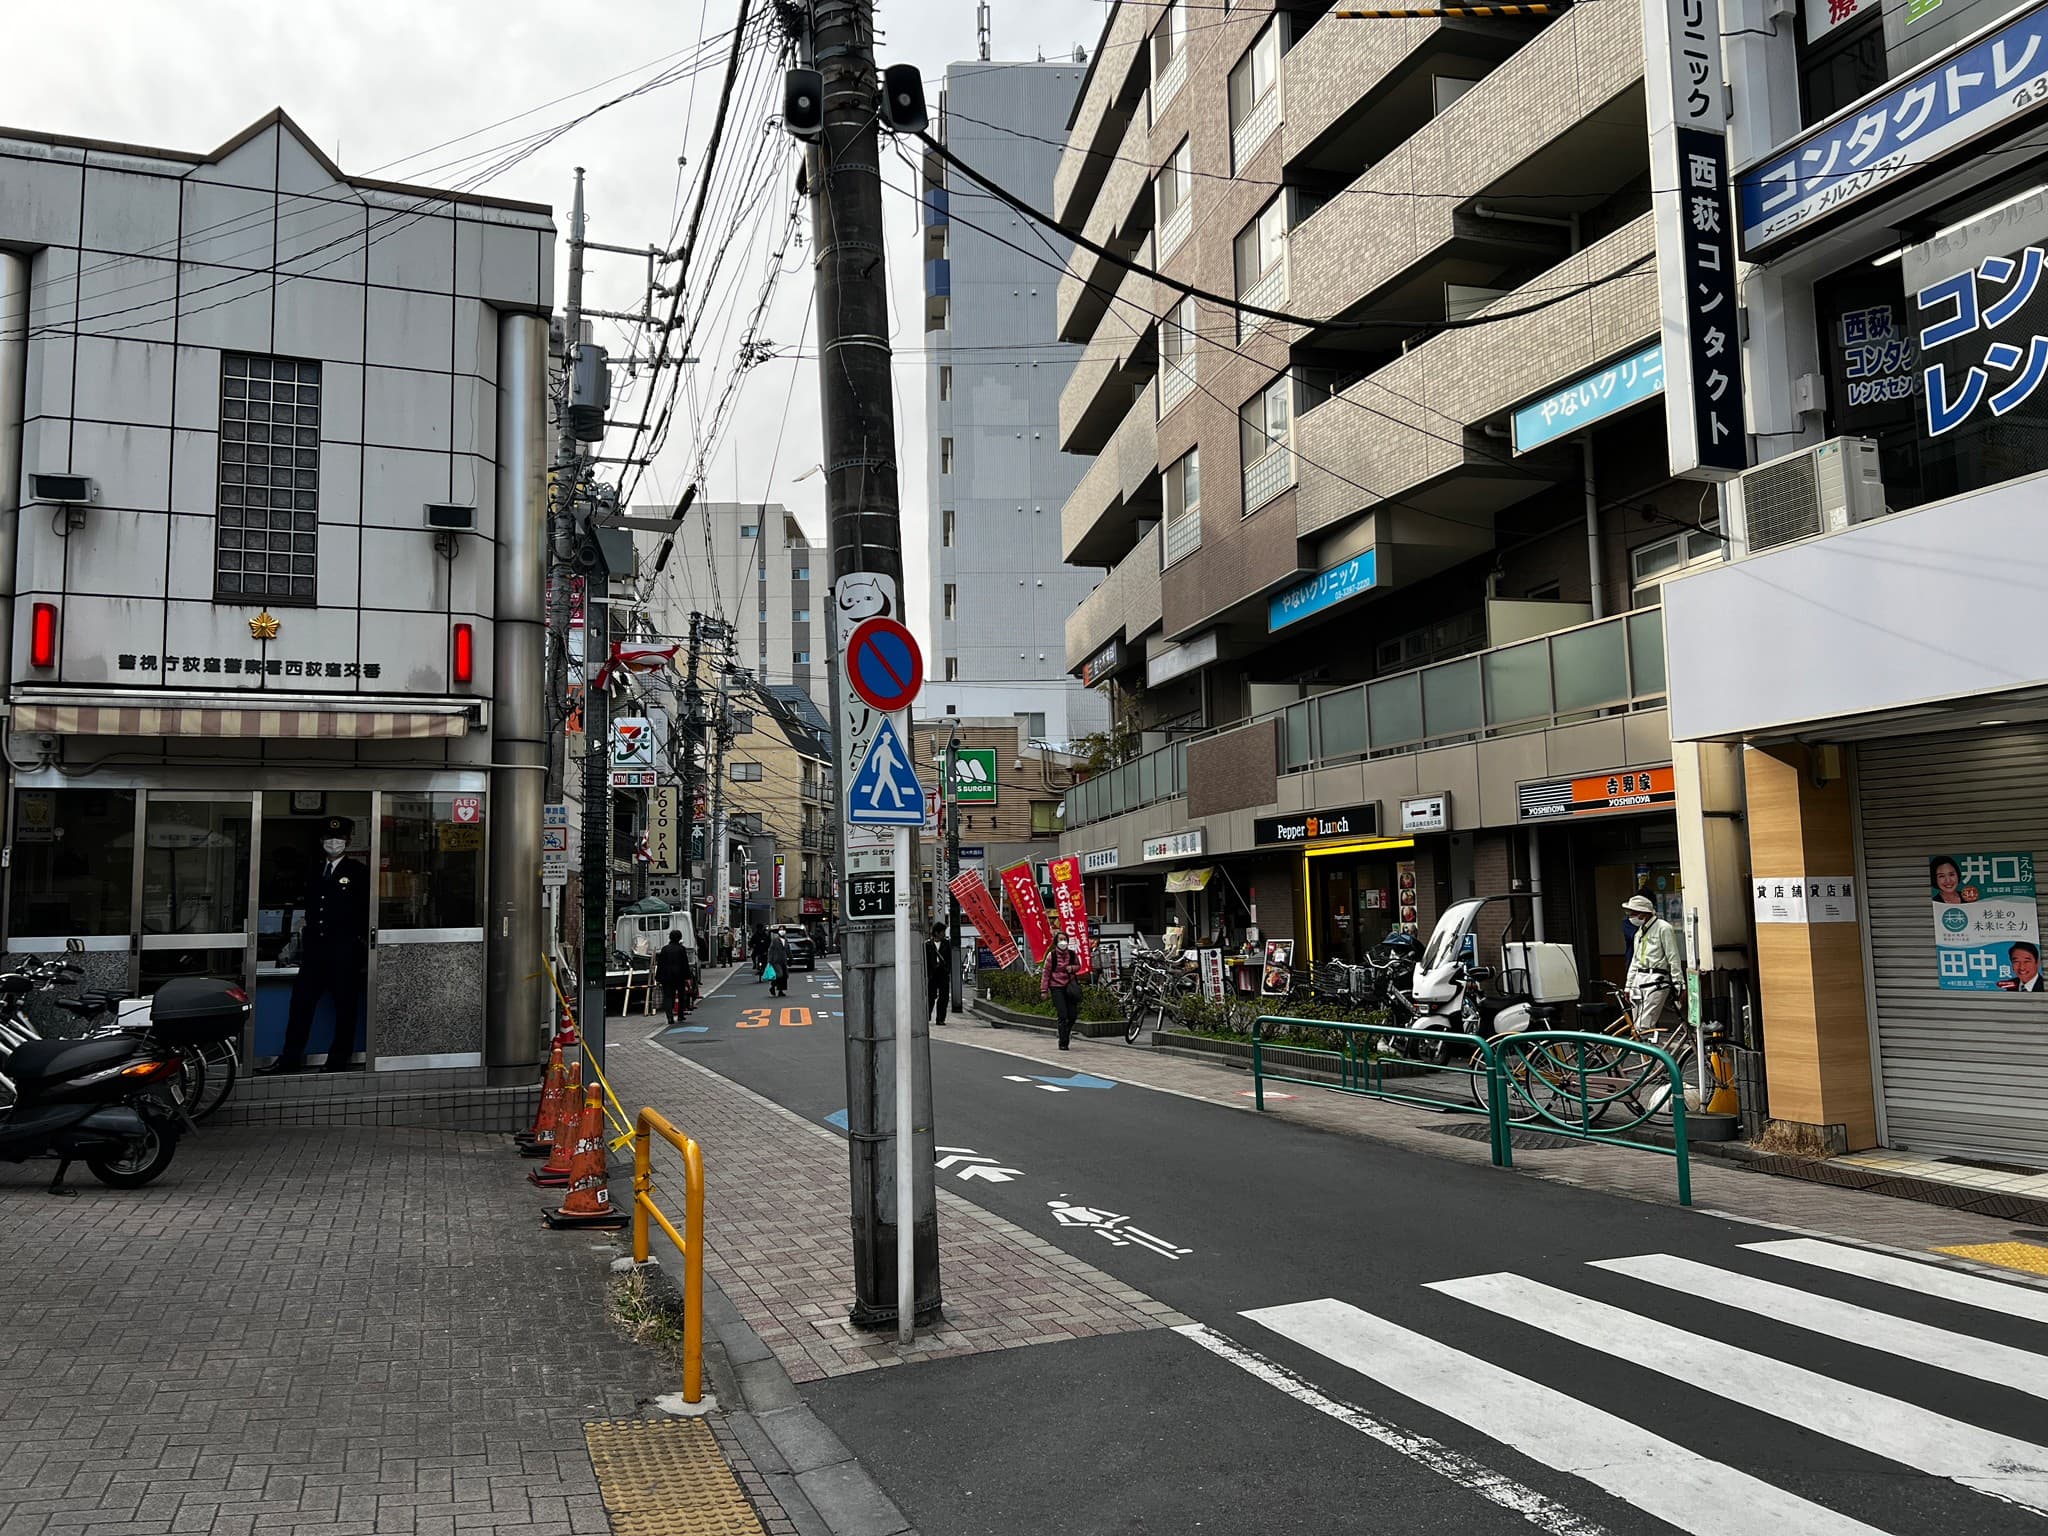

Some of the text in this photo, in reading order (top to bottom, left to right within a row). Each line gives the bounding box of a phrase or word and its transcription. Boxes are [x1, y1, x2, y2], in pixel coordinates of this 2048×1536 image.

[1760, 34, 2042, 213] コンタクトレ
[1763, 154, 1908, 238] メニコン メルスプラン
[1687, 153, 1730, 445] 西荻コンタクト
[1841, 304, 1893, 346] 西荻
[1540, 350, 1663, 426] やないクリニ
[1281, 560, 1359, 613] やないクリニック
[118, 654, 382, 679] 警視庁荻窪警察署西荻窪交番
[614, 776, 626, 784] ATM
[1605, 773, 1651, 796] 吉野家
[455, 799, 477, 807] AED
[657, 789, 668, 828] COCO
[1528, 804, 1566, 815] YOSHINOYA
[1608, 795, 1651, 807] YOSHINOYA
[691, 824, 704, 839] 本
[1277, 816, 1350, 840] Pepper Lunch
[1961, 855, 2033, 885] 井口 えみ
[854, 881, 890, 896] 西荻北
[1756, 884, 1803, 899] 貸店舗
[1809, 883, 1853, 898] 貸店舗
[858, 898, 883, 912] 3-1
[1983, 909, 2016, 920] 杉並の
[1974, 920, 2028, 932] 未来に全力
[1940, 949, 1998, 978] 田中
[735, 1007, 813, 1029] 30
